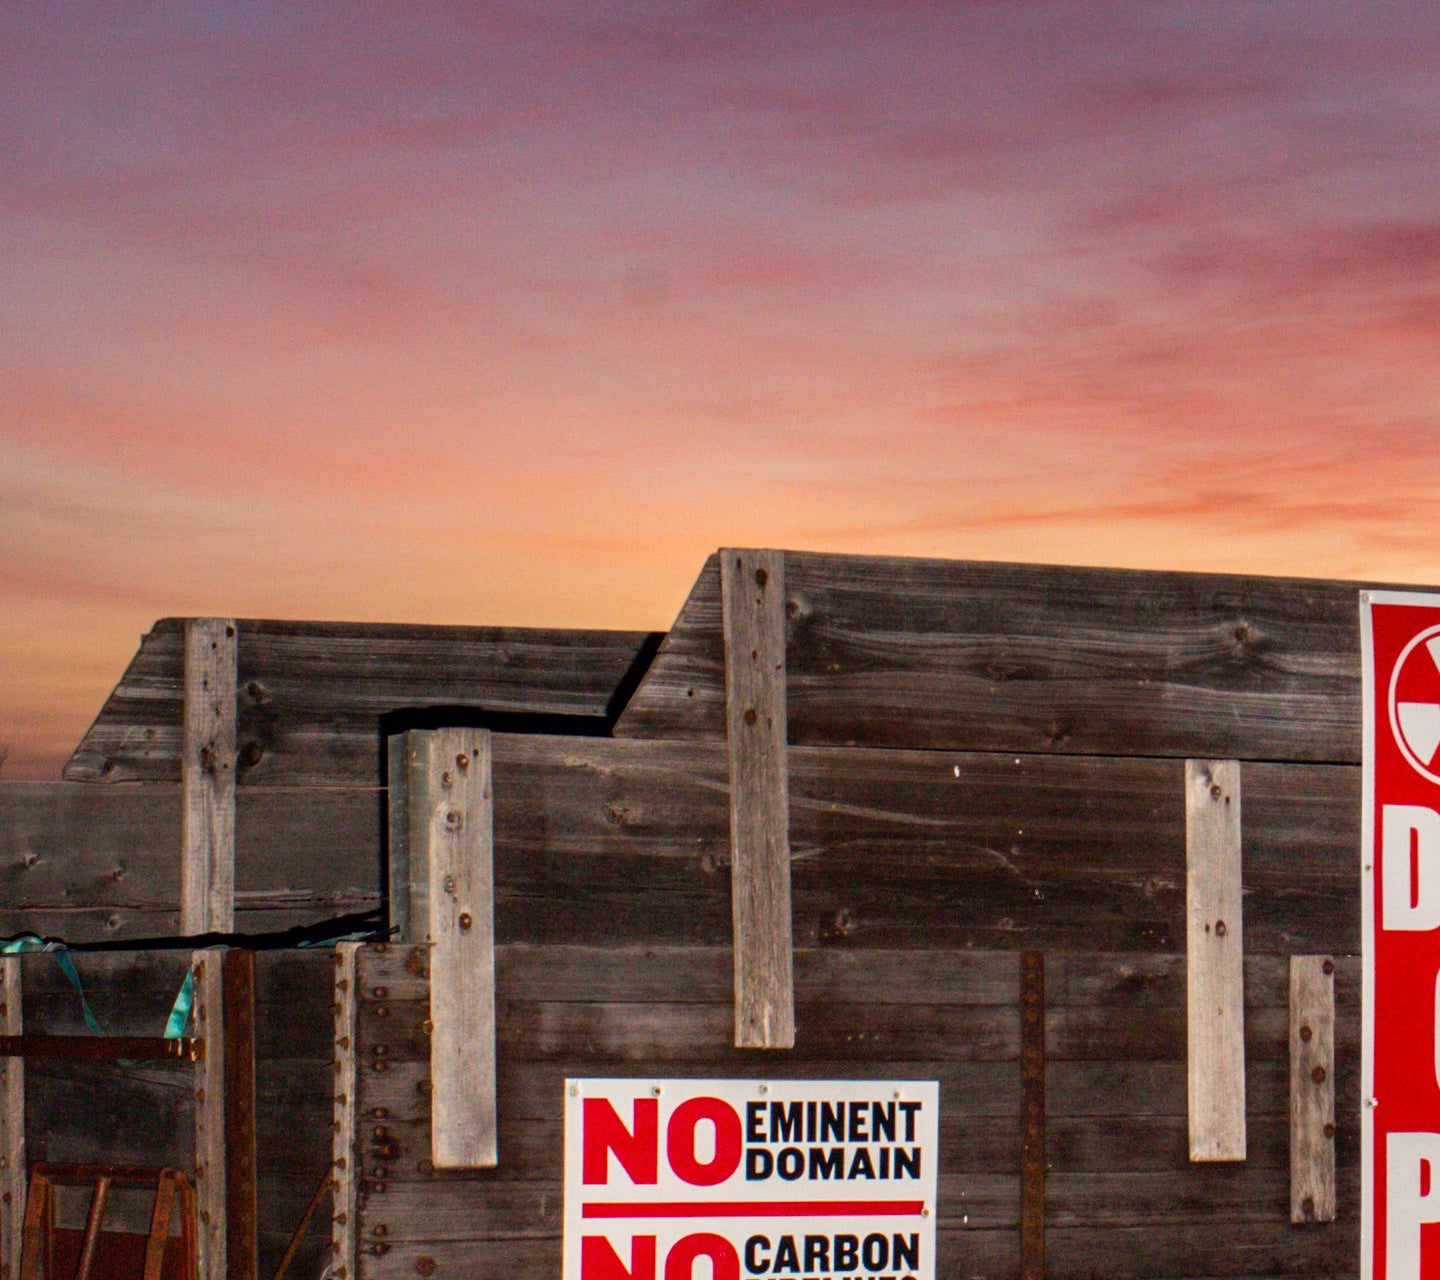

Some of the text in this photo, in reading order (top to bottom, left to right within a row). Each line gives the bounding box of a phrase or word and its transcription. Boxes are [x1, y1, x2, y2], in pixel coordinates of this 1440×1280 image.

[582, 1096, 742, 1187] NO
[746, 1101, 922, 1143] EMINENT
[745, 1147, 921, 1182] DOMAIN
[744, 1233, 920, 1274] CARBON
